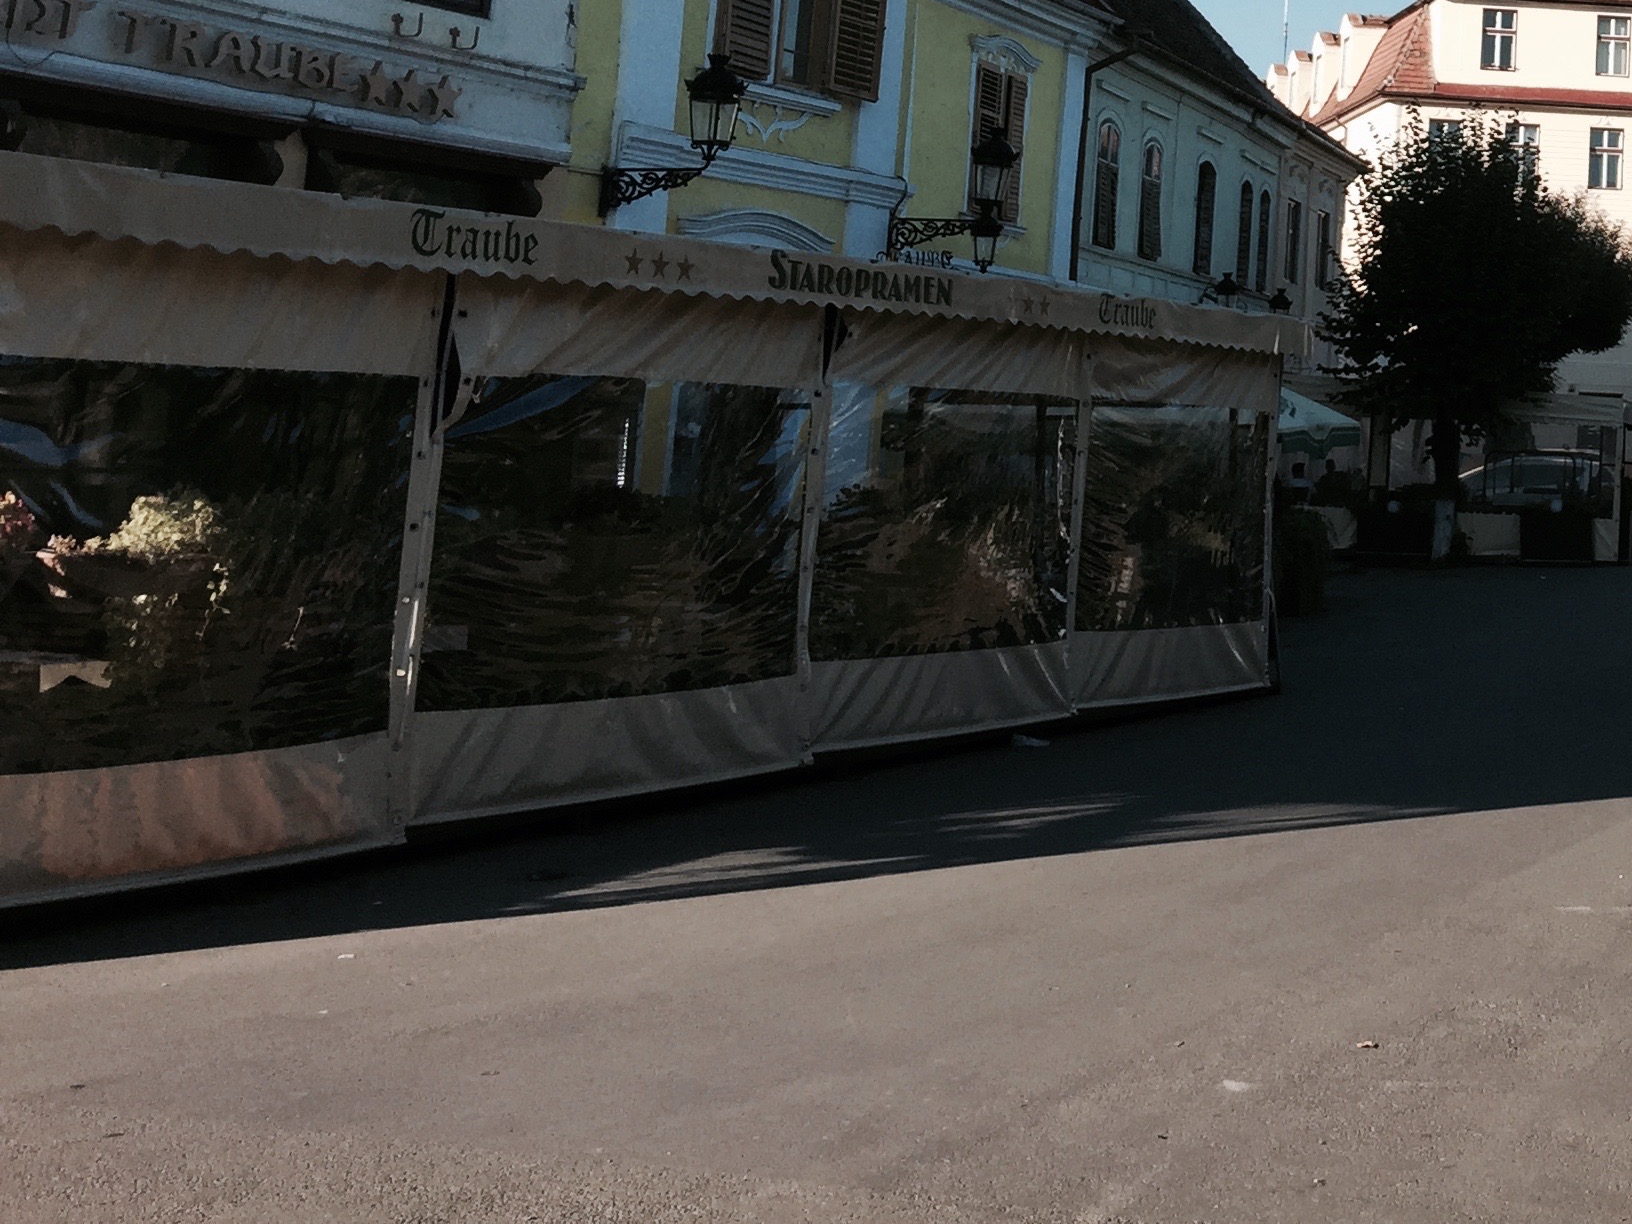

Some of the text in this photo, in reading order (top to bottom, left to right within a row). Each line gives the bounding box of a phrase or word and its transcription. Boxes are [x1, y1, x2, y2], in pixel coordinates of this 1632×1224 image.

[115, 8, 360, 93] TRAUBE
[409, 207, 540, 266] Traube
[767, 249, 954, 307] STAROPRAMEN
[1098, 292, 1157, 330] Traube
